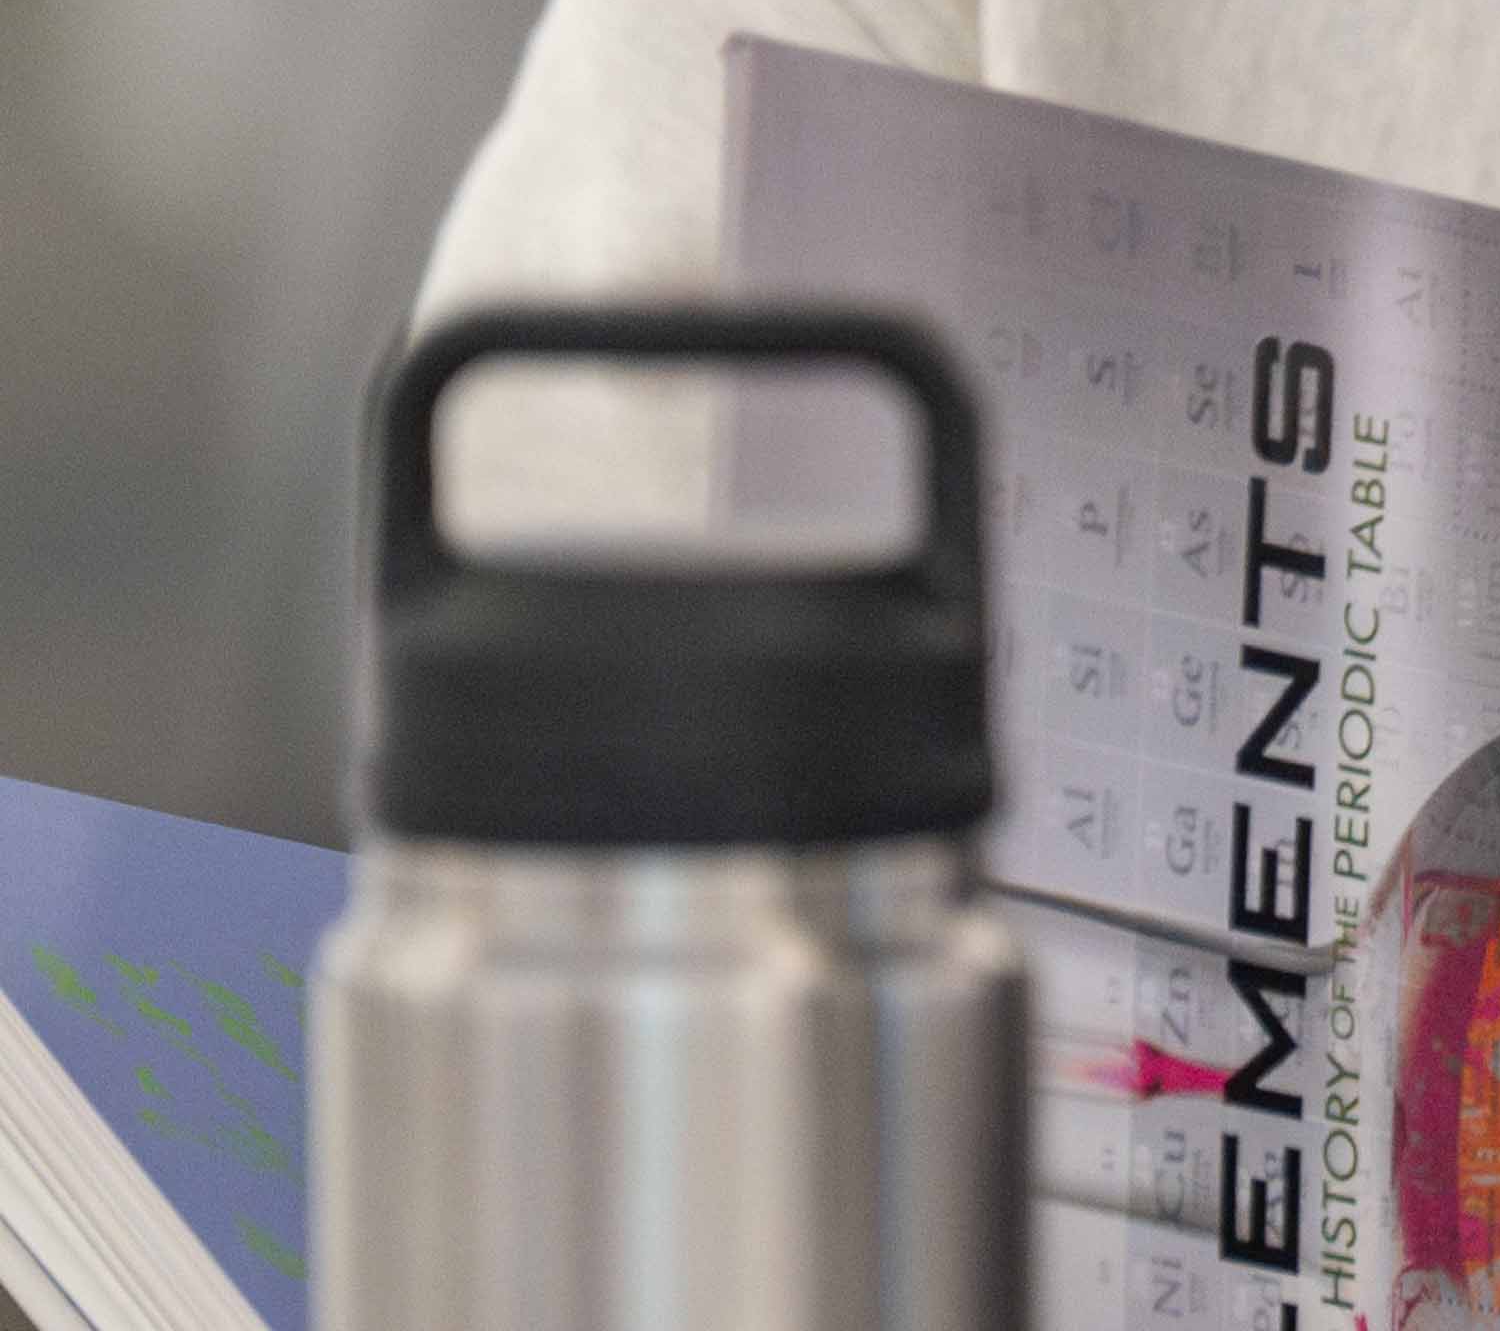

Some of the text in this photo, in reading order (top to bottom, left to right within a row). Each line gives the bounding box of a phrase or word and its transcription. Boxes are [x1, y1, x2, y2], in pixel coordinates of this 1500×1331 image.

[1185, 361, 1217, 429] Se
[1076, 500, 1109, 538] P
[1177, 506, 1212, 580] As
[1170, 652, 1202, 729] Ge
[1060, 782, 1098, 852] Al
[1164, 803, 1198, 878] Ga
[1220, 337, 1333, 1331] EMENTS
[1320, 413, 1389, 1310] HISTORY OF THE PERIODIC TABLE
[1159, 966, 1193, 1045] Zn
[1154, 1129, 1186, 1221] Cu
[1151, 1256, 1184, 1318] Ni
